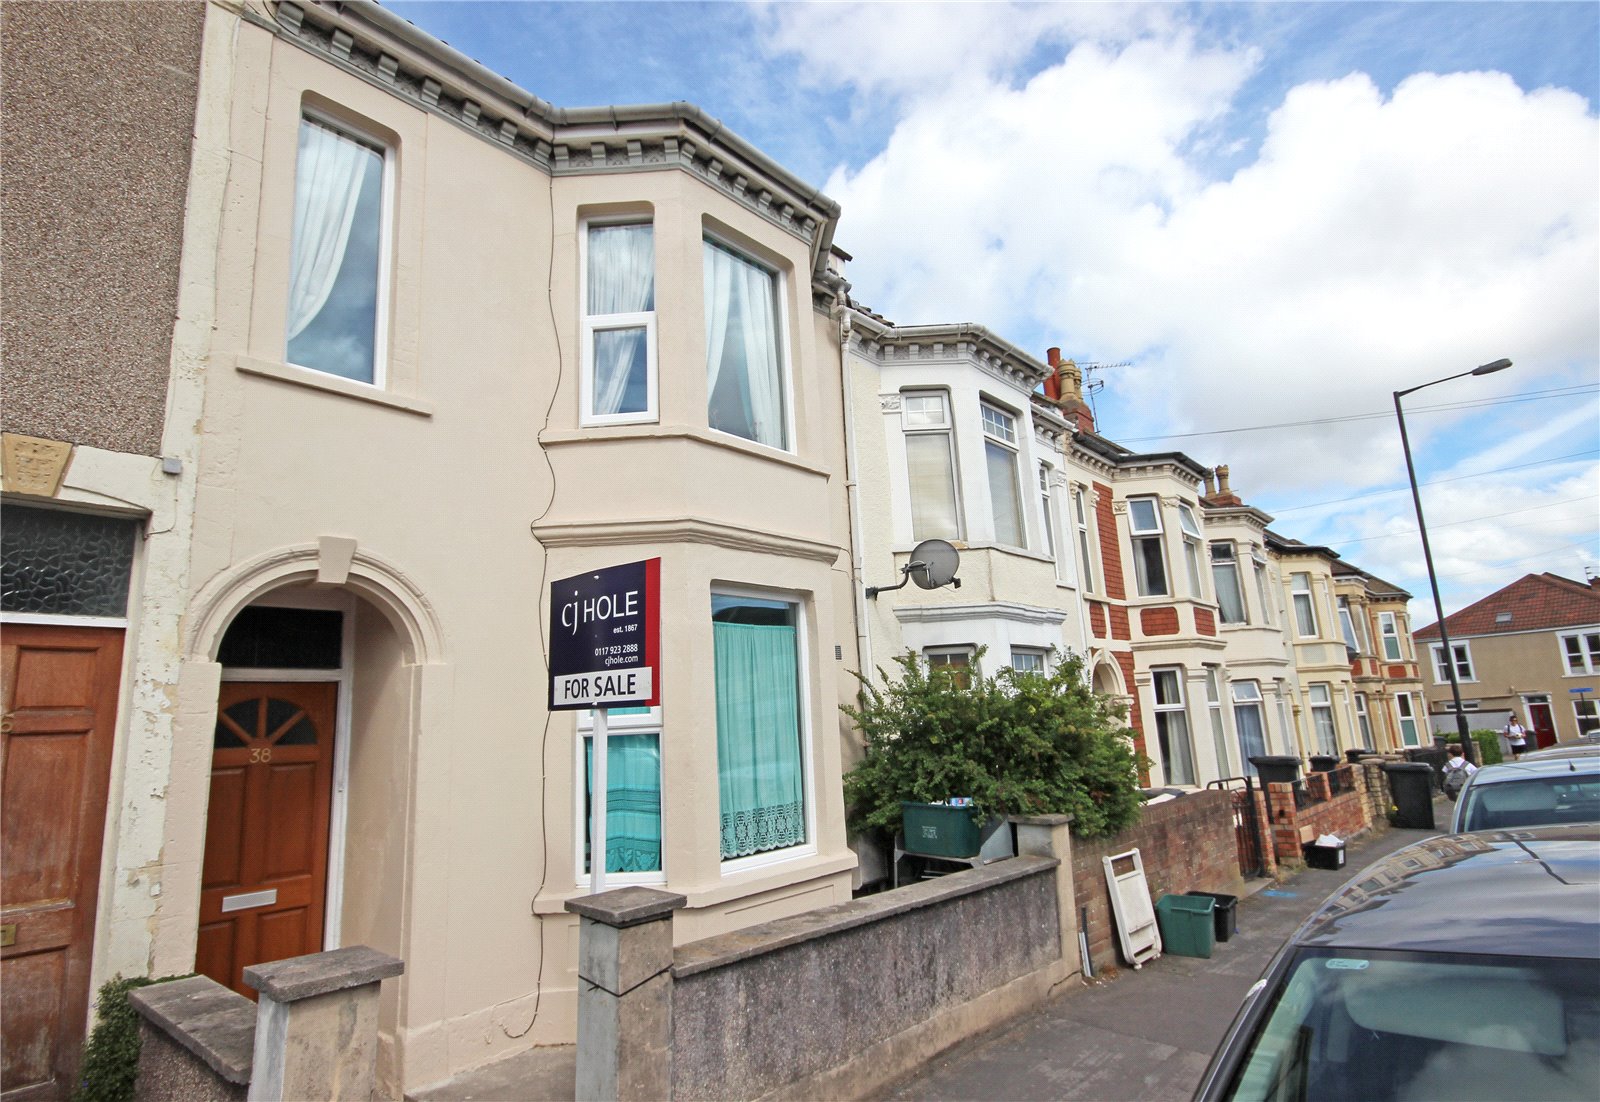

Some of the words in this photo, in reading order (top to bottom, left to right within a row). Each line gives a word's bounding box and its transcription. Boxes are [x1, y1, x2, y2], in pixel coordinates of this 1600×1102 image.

[583, 590, 638, 623] HOLE
[613, 626, 624, 634] est.
[624, 623, 638, 633] 1867
[594, 646, 609, 657] 0117
[609, 645, 622, 655] 923
[622, 643, 639, 654] 2888
[604, 655, 639, 667] cjhole.com
[564, 677, 590, 700] FOR
[594, 673, 637, 698] SALE
[249, 748, 272, 764] 38
